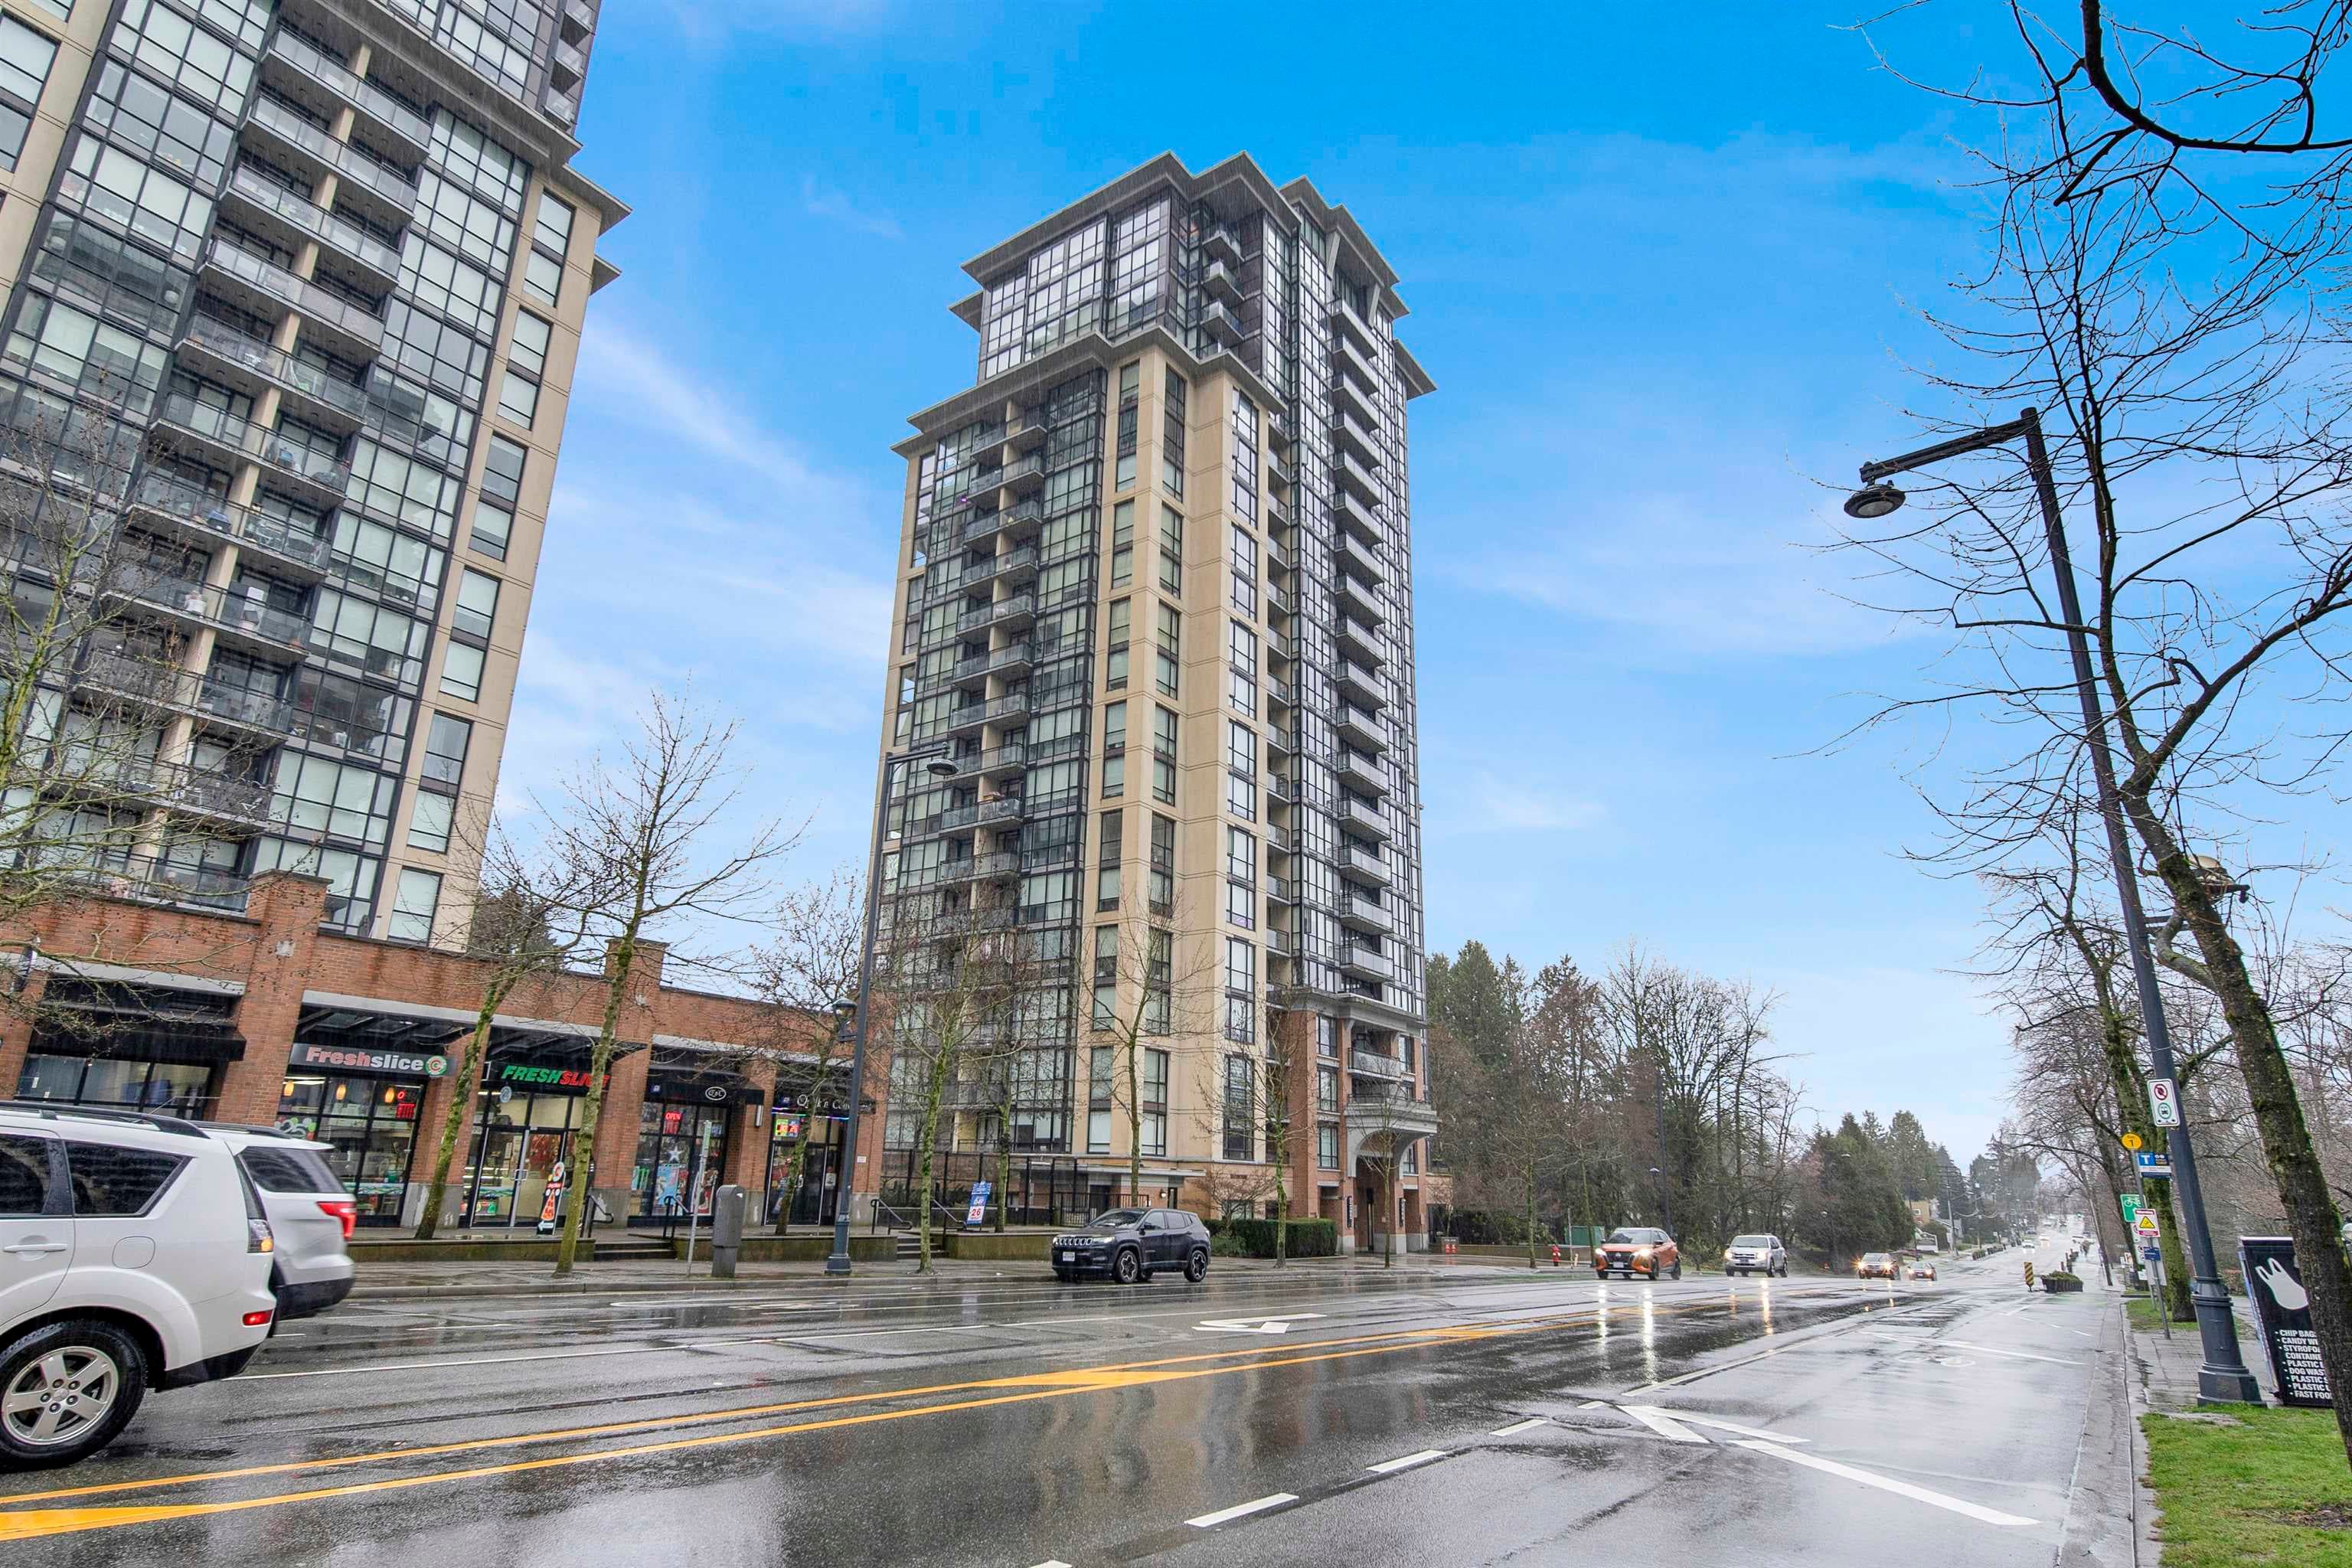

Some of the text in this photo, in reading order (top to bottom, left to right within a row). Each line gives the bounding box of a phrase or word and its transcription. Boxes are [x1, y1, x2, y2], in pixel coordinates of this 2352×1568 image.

[306, 1047, 423, 1071] Freshslice
[2292, 1383, 2325, 1391] PLASTIC
[2295, 1390, 2314, 1399] FAST
